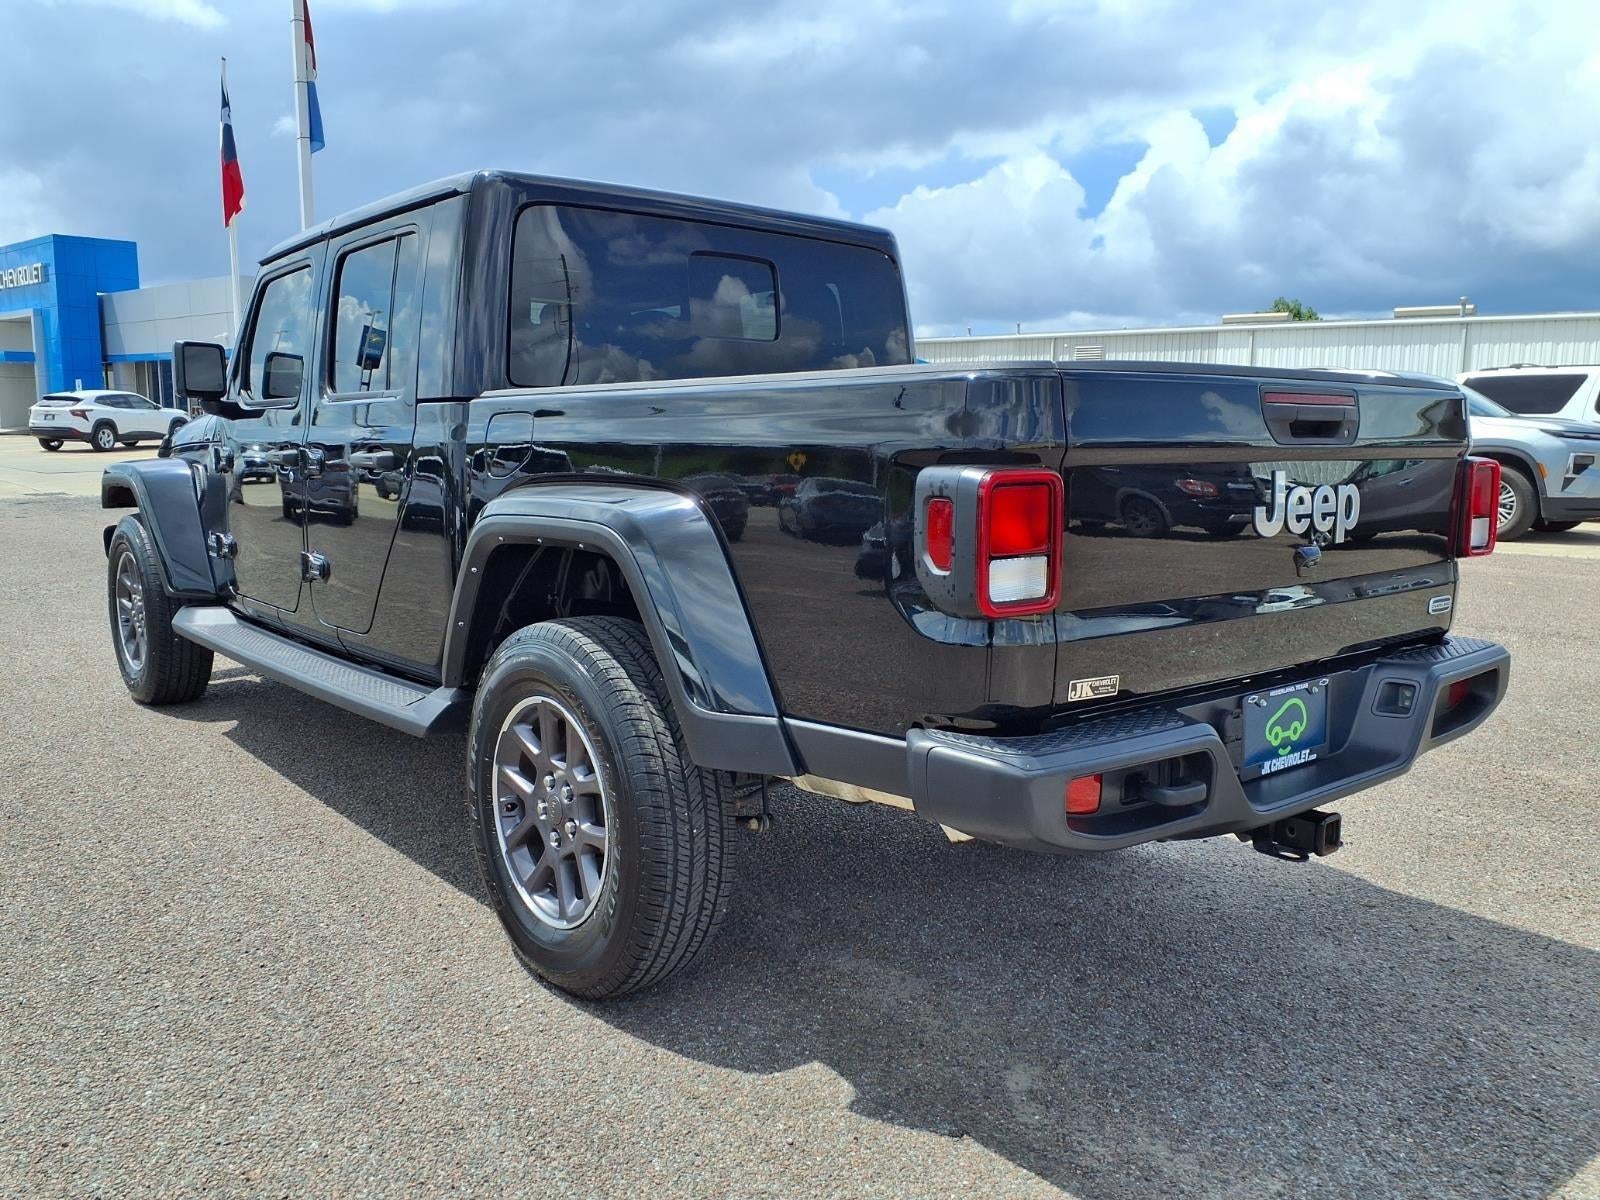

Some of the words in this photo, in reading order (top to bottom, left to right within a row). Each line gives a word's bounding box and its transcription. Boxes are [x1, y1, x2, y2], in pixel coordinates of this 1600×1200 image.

[1254, 470, 1361, 544] Jeep
[1070, 681, 1095, 699] JK
[1261, 760, 1272, 775] JK
